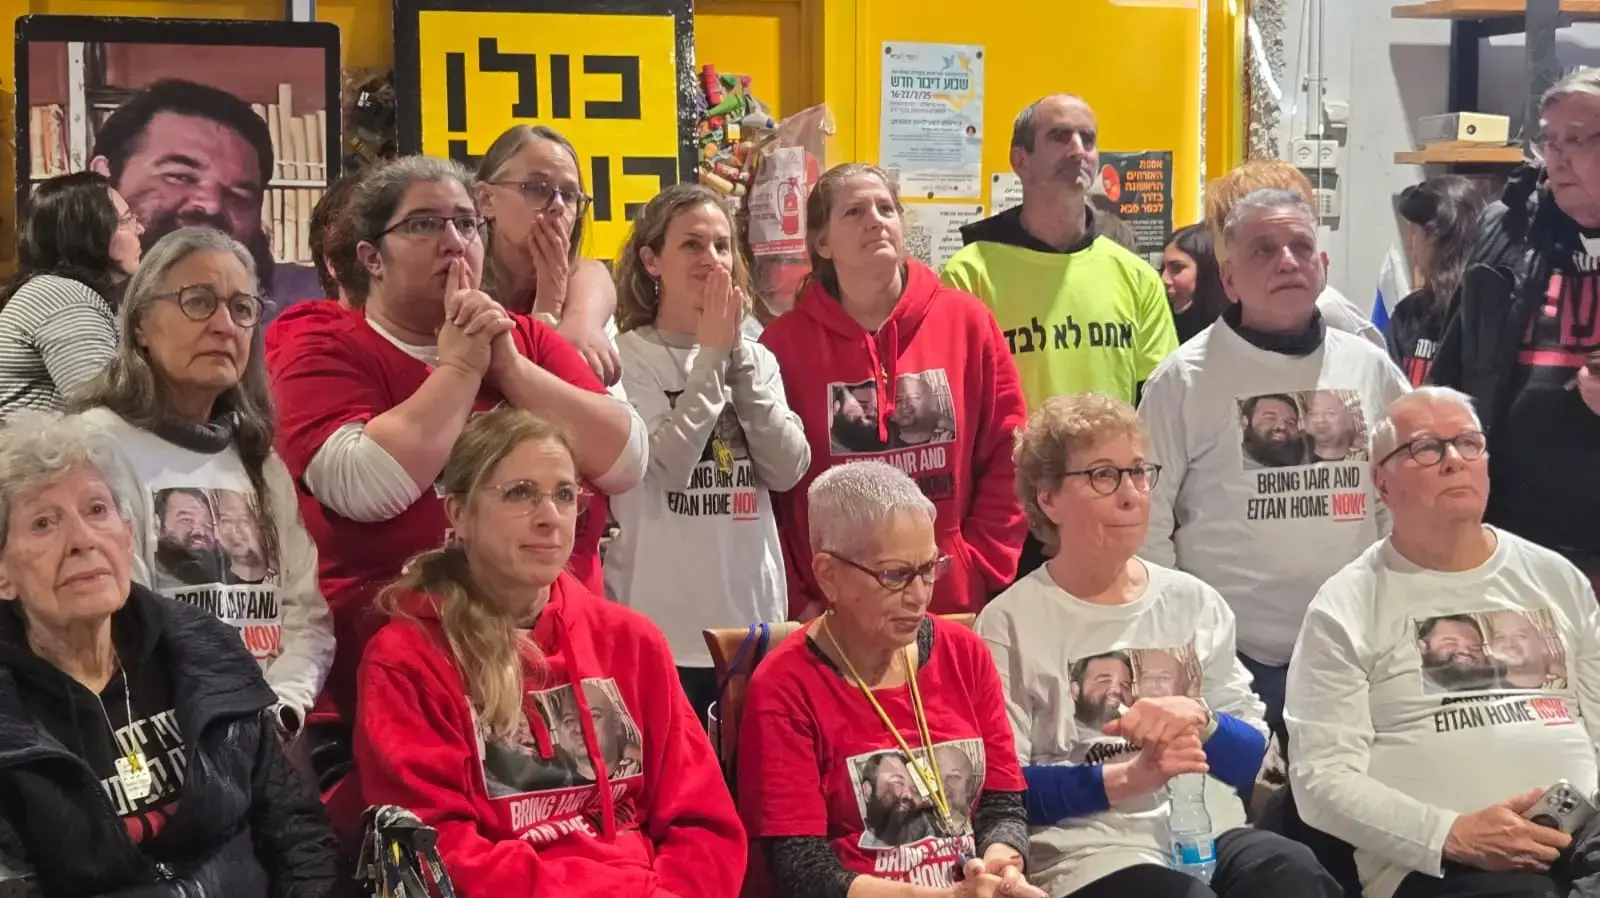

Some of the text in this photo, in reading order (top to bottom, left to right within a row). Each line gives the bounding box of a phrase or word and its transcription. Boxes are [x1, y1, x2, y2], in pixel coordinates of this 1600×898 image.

[446, 37, 641, 132] כולן
[890, 75, 969, 90] שבוע דיבור חדש
[1003, 315, 1133, 355] אתם לא לבד
[919, 447, 946, 471] AND
[1257, 466, 1360, 494] BRING IAIR AND
[667, 492, 699, 516] EITAN
[702, 493, 731, 515] HOME
[1247, 492, 1366, 520] EITAN HOME NOW!
[247, 591, 278, 619] AND
[1434, 706, 1485, 733] EITAN
[1485, 700, 1536, 725] HOME
[510, 795, 557, 832] BRING
[874, 845, 929, 873] BRING
